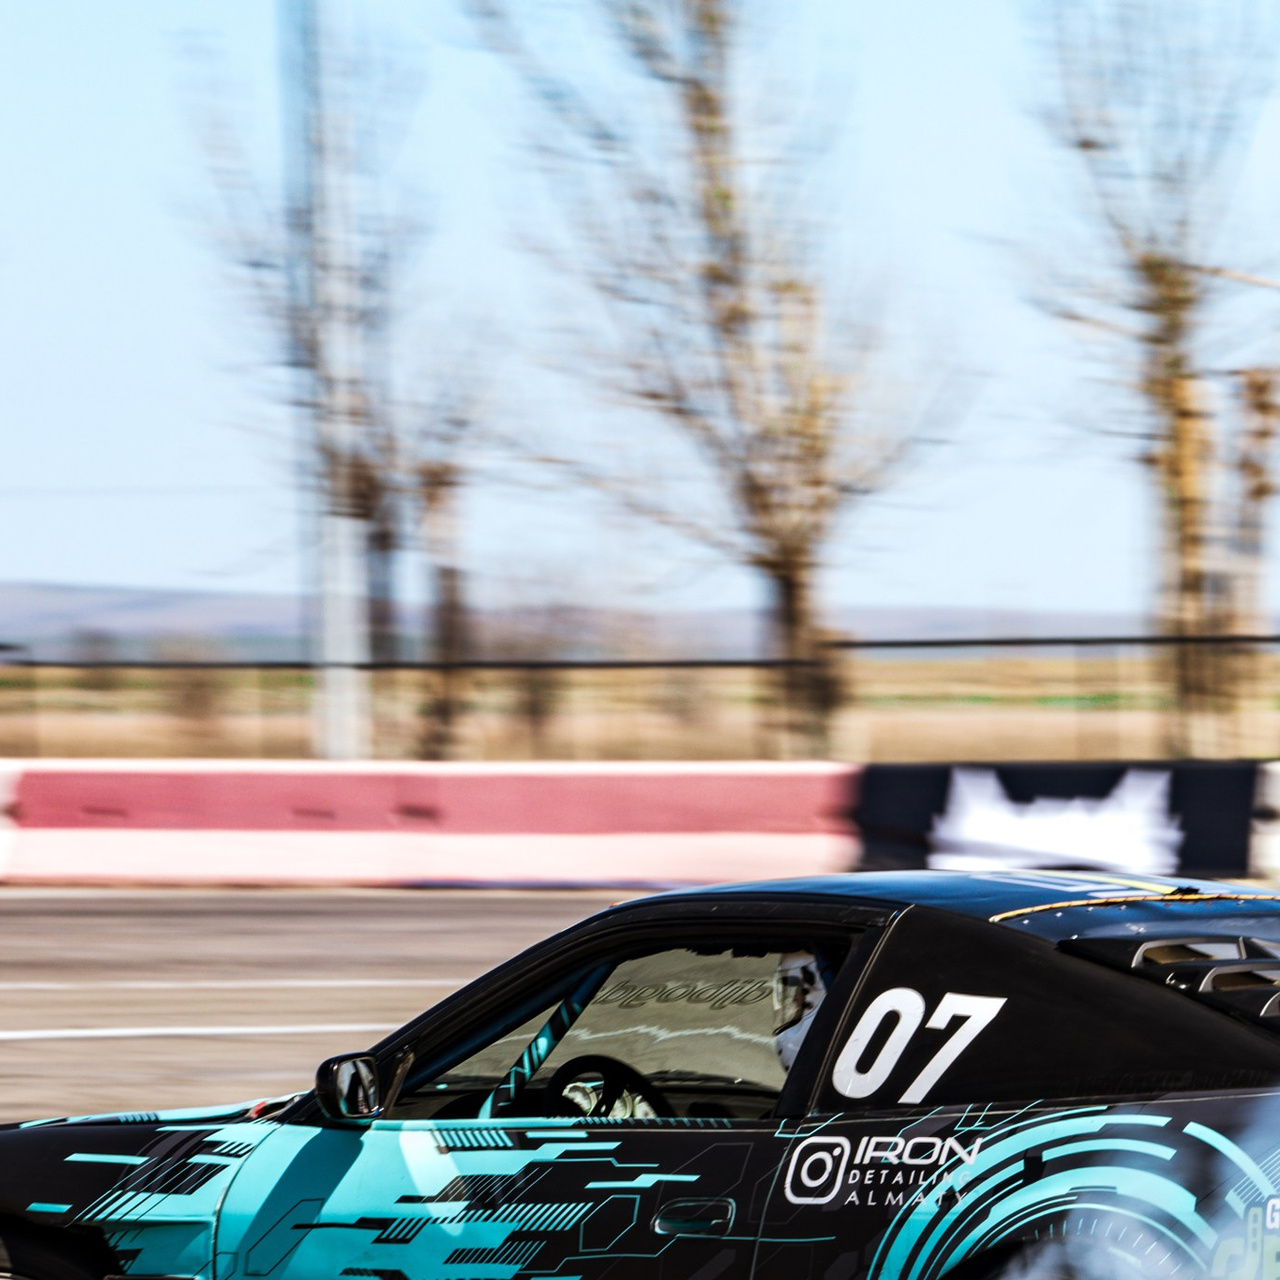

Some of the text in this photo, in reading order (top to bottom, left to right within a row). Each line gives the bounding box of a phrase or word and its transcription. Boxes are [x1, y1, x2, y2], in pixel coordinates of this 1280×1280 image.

[832, 987, 1008, 1105] 07
[853, 1136, 984, 1165] IRON
[848, 1169, 972, 1186] DETAILING
[844, 1190, 968, 1206] ALMATY
